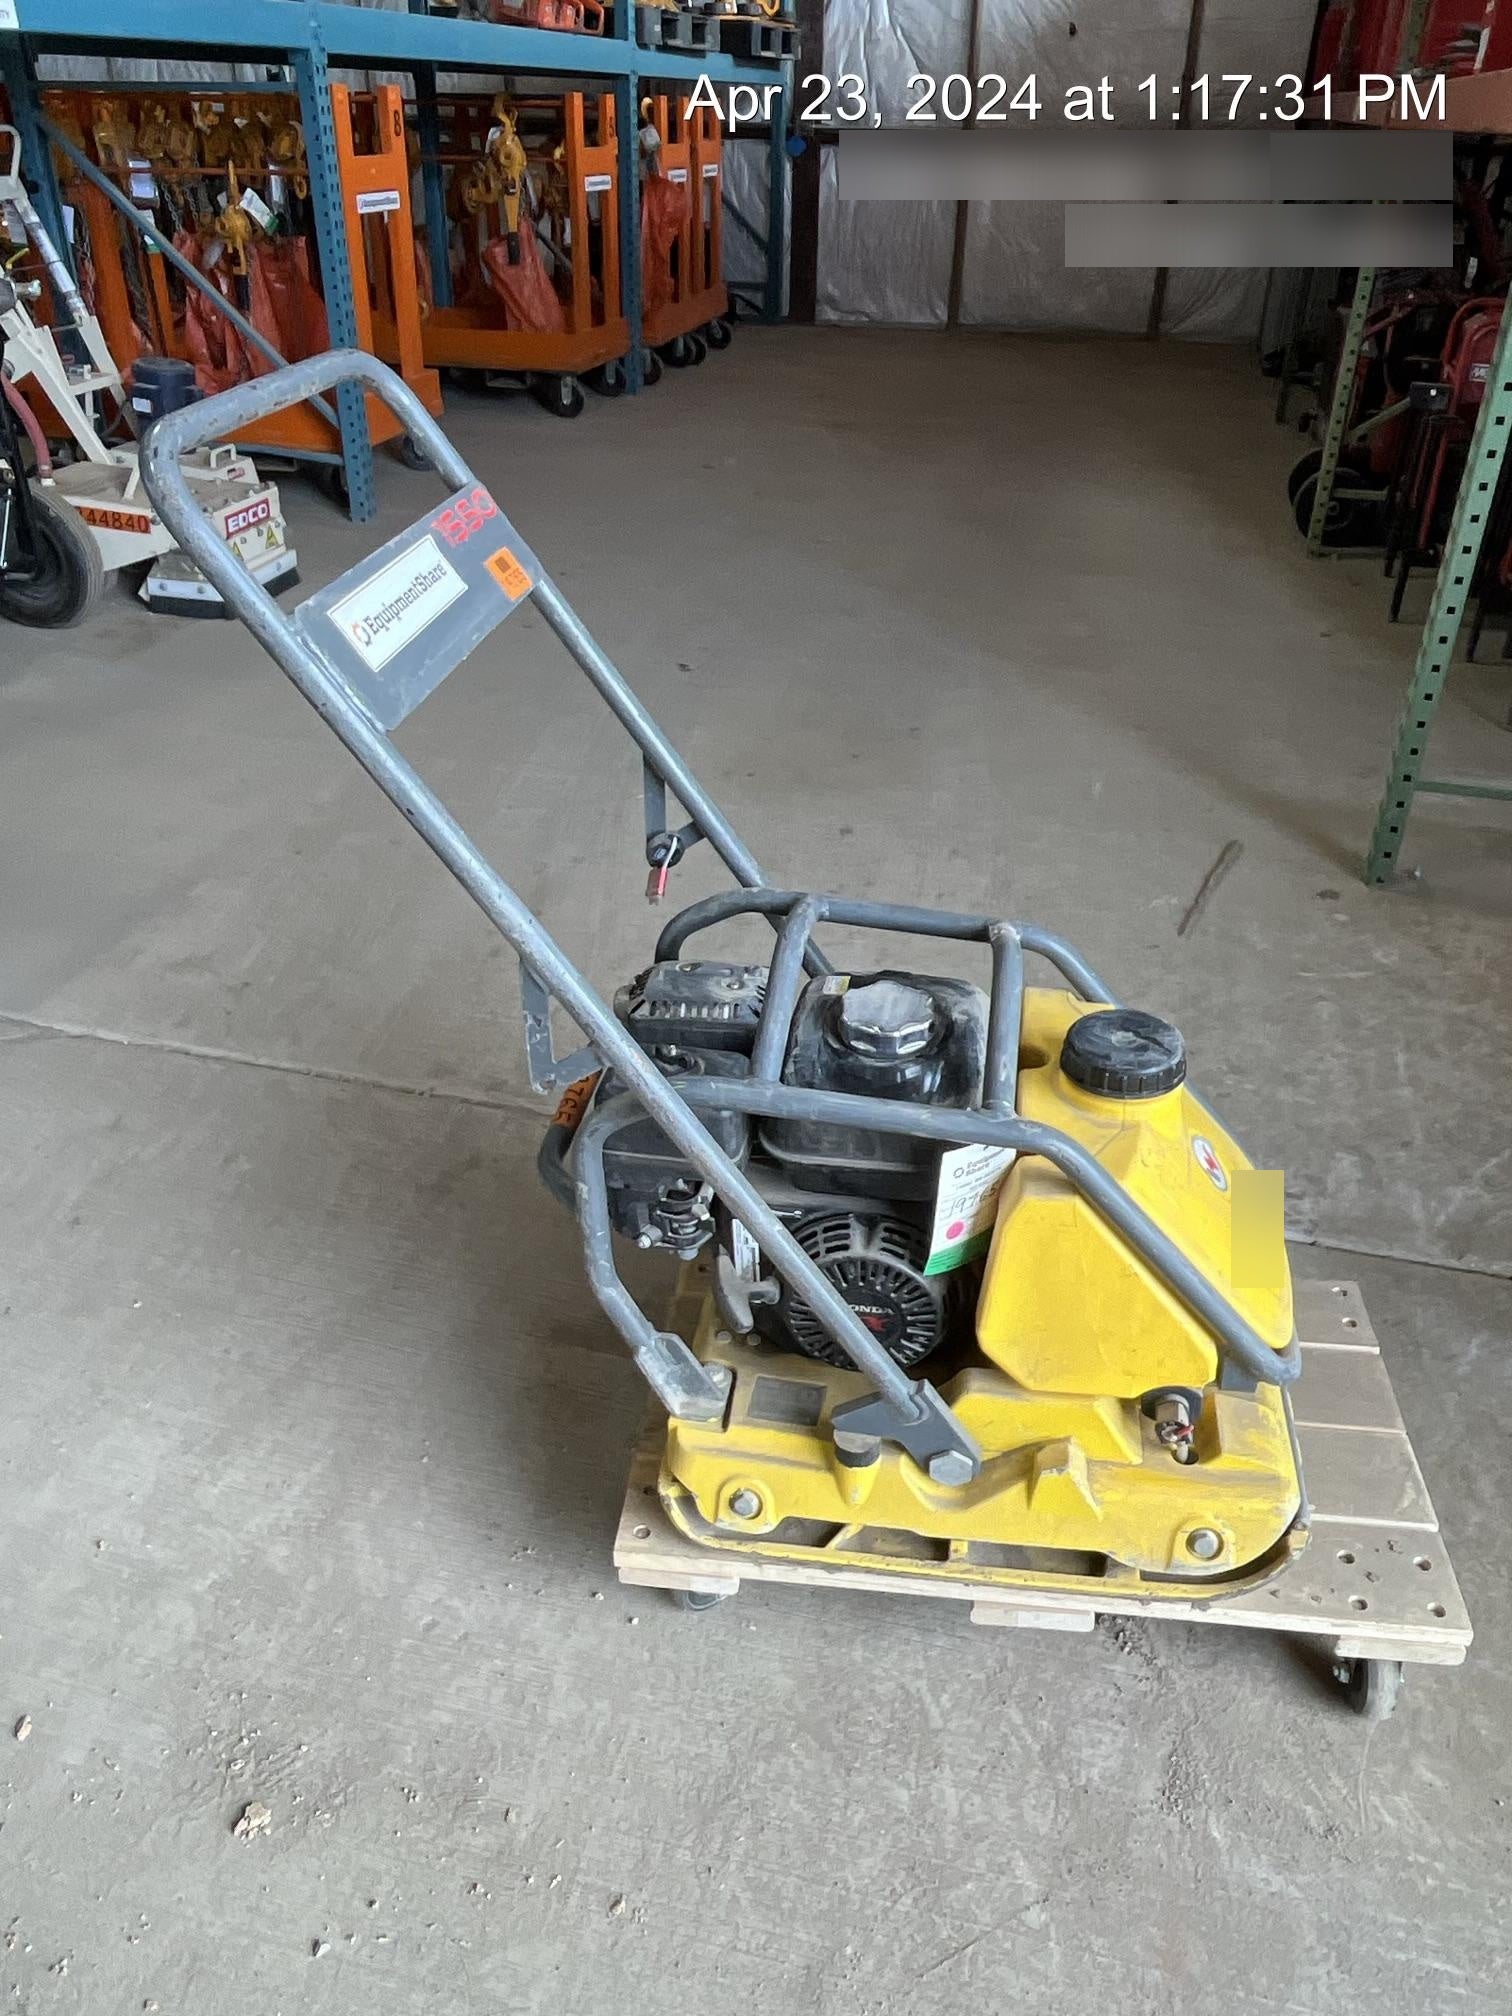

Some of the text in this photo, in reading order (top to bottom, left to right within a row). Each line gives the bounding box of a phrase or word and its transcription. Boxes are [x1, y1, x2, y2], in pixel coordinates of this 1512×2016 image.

[79, 508, 150, 533] 44840
[227, 503, 269, 533] EDCO
[363, 559, 449, 637] EquipmentShare
[554, 1075, 590, 1122] 765
[848, 1303, 895, 1315] ONDA
